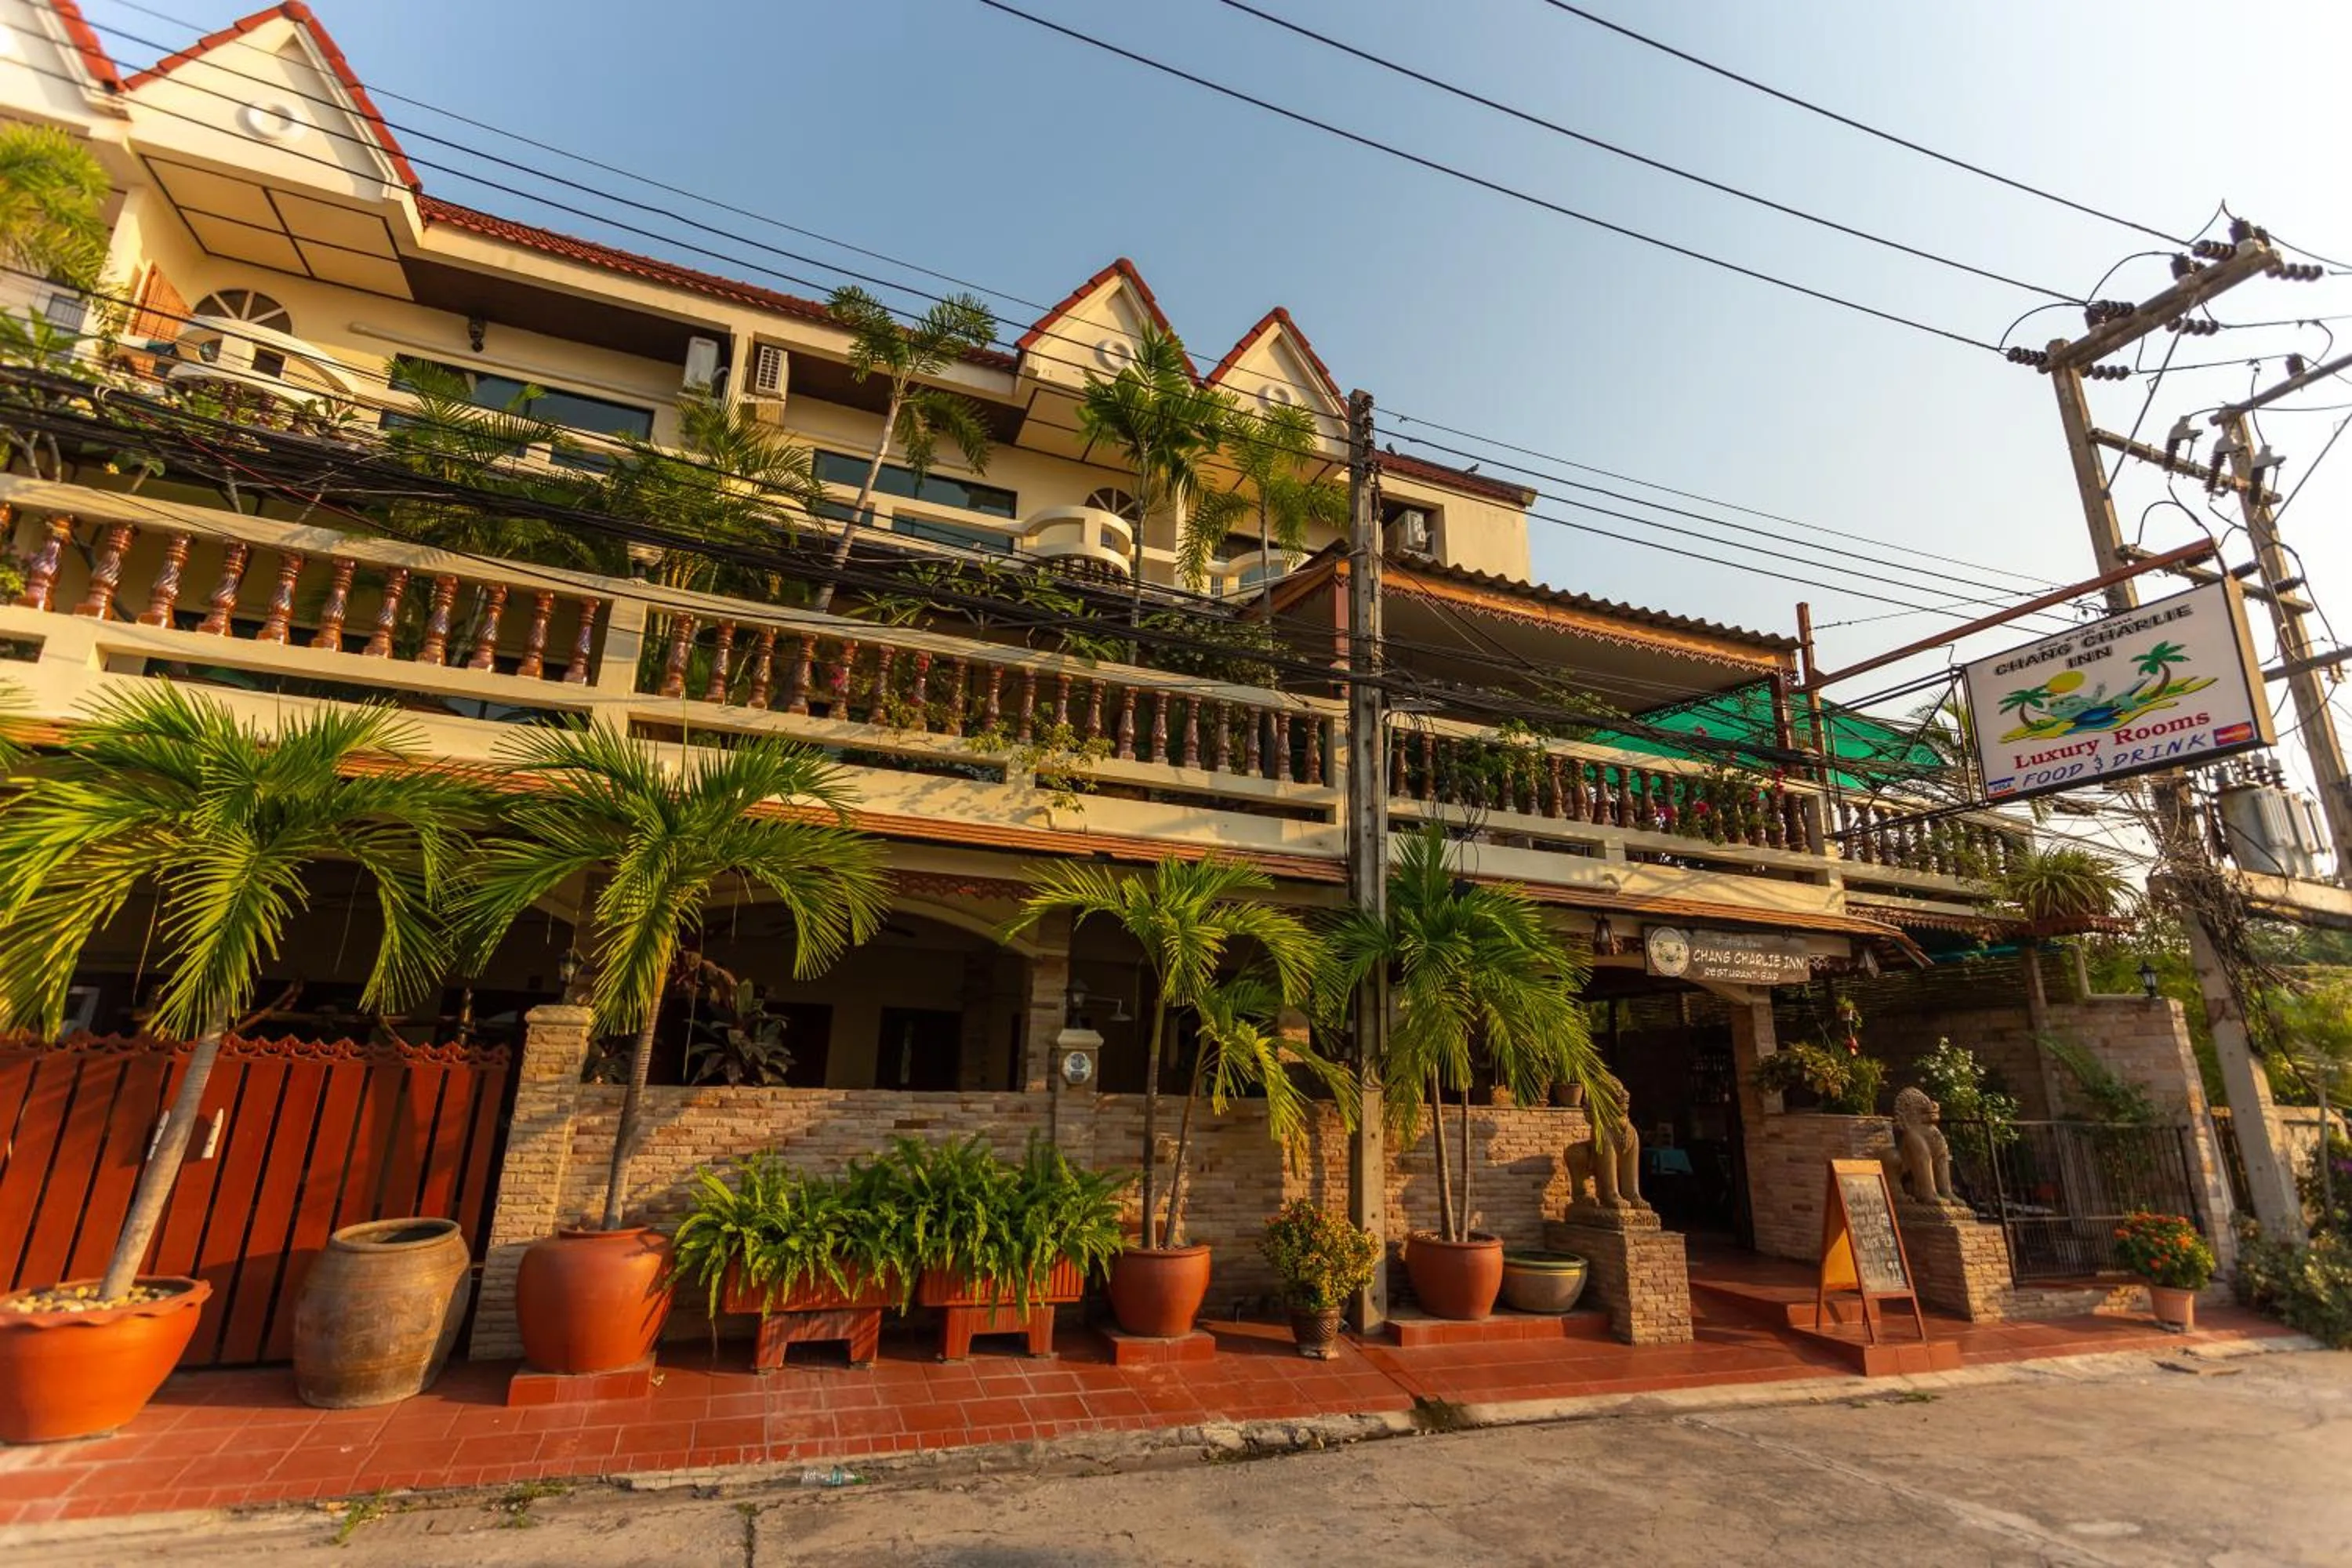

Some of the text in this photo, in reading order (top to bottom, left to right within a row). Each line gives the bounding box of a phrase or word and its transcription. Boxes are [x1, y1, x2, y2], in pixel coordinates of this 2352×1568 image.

[1994, 644, 2074, 676] CHANG
[2081, 604, 2194, 648] CHARLIE
[2066, 645, 2113, 669] INN
[2013, 711, 2211, 770] Luxury Rooms
[2022, 763, 2085, 788] FOOD
[2113, 732, 2207, 768] DRINK
[1693, 949, 1804, 970] CHANG CHARLIE INN
